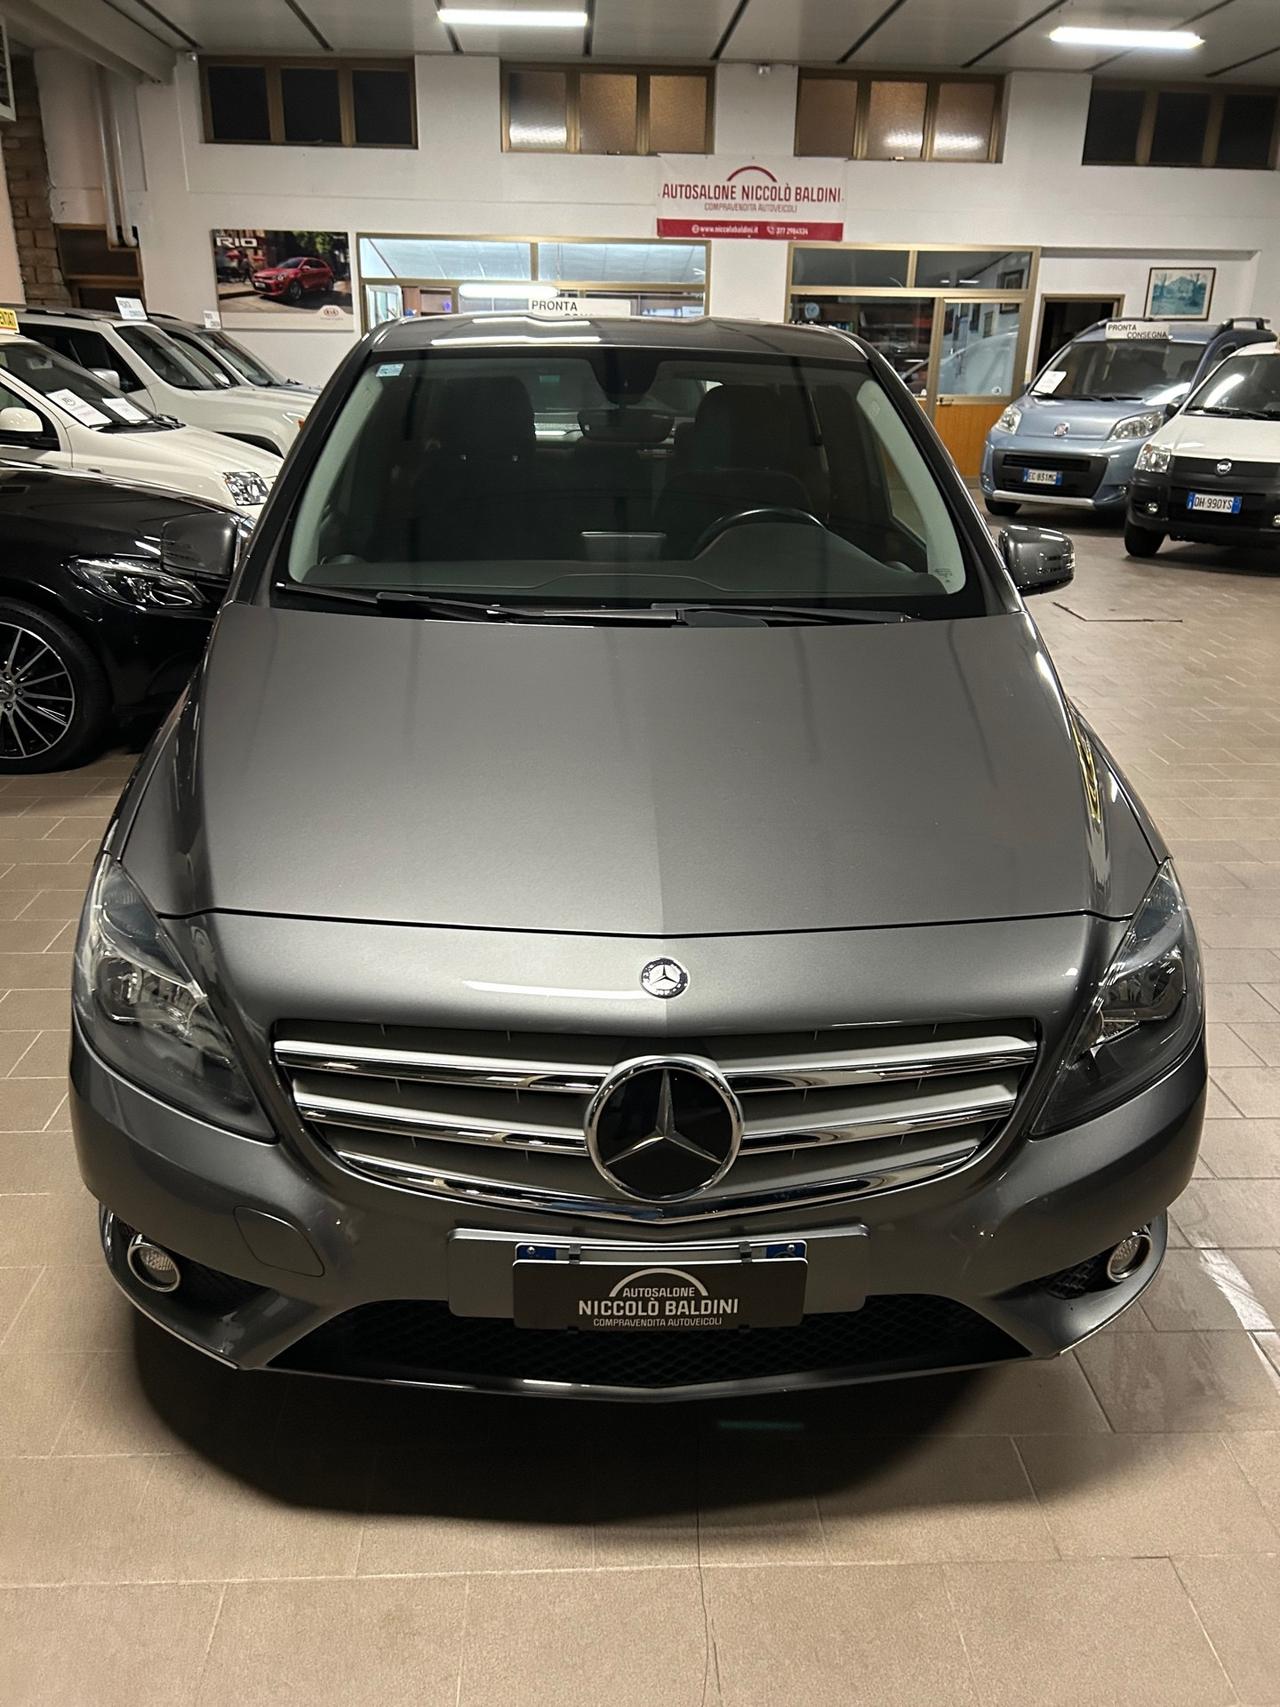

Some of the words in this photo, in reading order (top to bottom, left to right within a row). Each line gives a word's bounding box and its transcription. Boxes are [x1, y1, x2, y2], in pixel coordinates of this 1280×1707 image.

[662, 183, 737, 200] AUTOSALONE
[741, 182, 792, 202] NICCOLÒ
[794, 186, 841, 203] BALDINI
[704, 202, 757, 212] COMPRAVENDITA
[758, 203, 798, 213] AUTOVEICOLI
[216, 236, 258, 249] RIO
[531, 300, 578, 312] PRONTA
[1107, 323, 1137, 331] PRONTA
[1126, 330, 1168, 340] CONSEGNA
[622, 1287, 696, 1298] AUTOSALONE
[578, 1297, 659, 1316] NICCOLÒ
[665, 1298, 739, 1316] BALDINI
[593, 1318, 666, 1327] COMPRAVENDITA
[667, 1317, 722, 1327] AUTOVEICOLI
